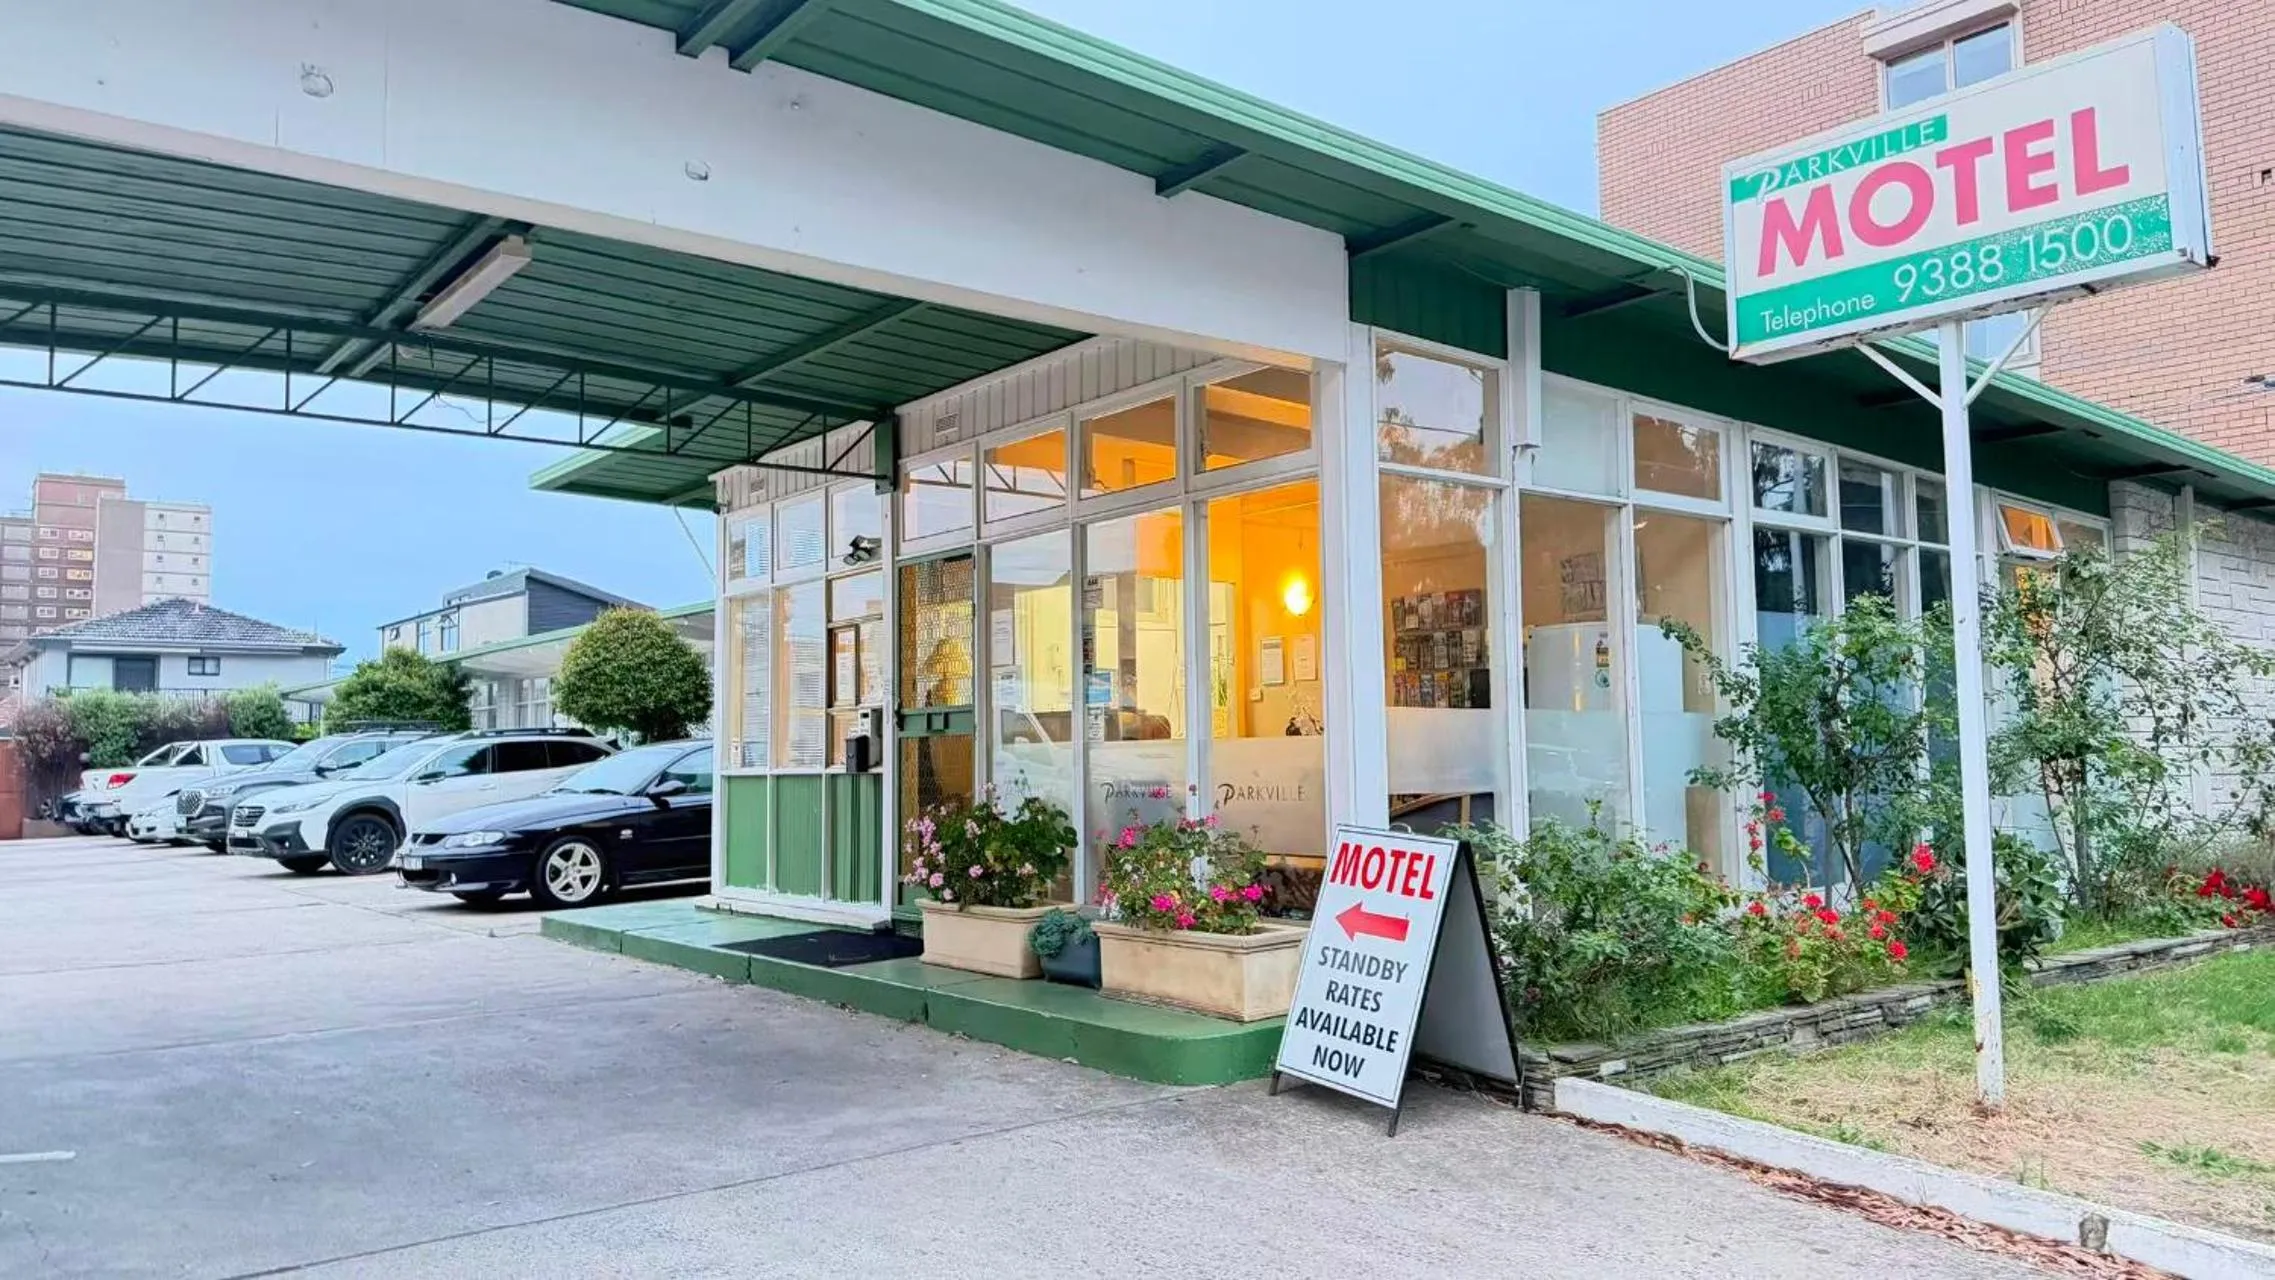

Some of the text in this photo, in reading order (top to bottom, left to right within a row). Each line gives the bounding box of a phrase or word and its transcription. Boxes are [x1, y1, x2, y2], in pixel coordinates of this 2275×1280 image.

[1745, 119, 1937, 204] PARKVILLE
[1757, 106, 2131, 278] MOTEL
[1760, 214, 2133, 334] Telephone 9388 1500
[1100, 782, 1172, 805] PARKVE
[1217, 783, 1305, 805] PARKVILLE
[1330, 842, 1437, 900] MOTEL
[1318, 945, 1409, 984] STANDBY
[1325, 980, 1383, 1013] RATES
[1295, 1006, 1399, 1053] AVAILABLE
[1312, 1045, 1366, 1079] NOW
